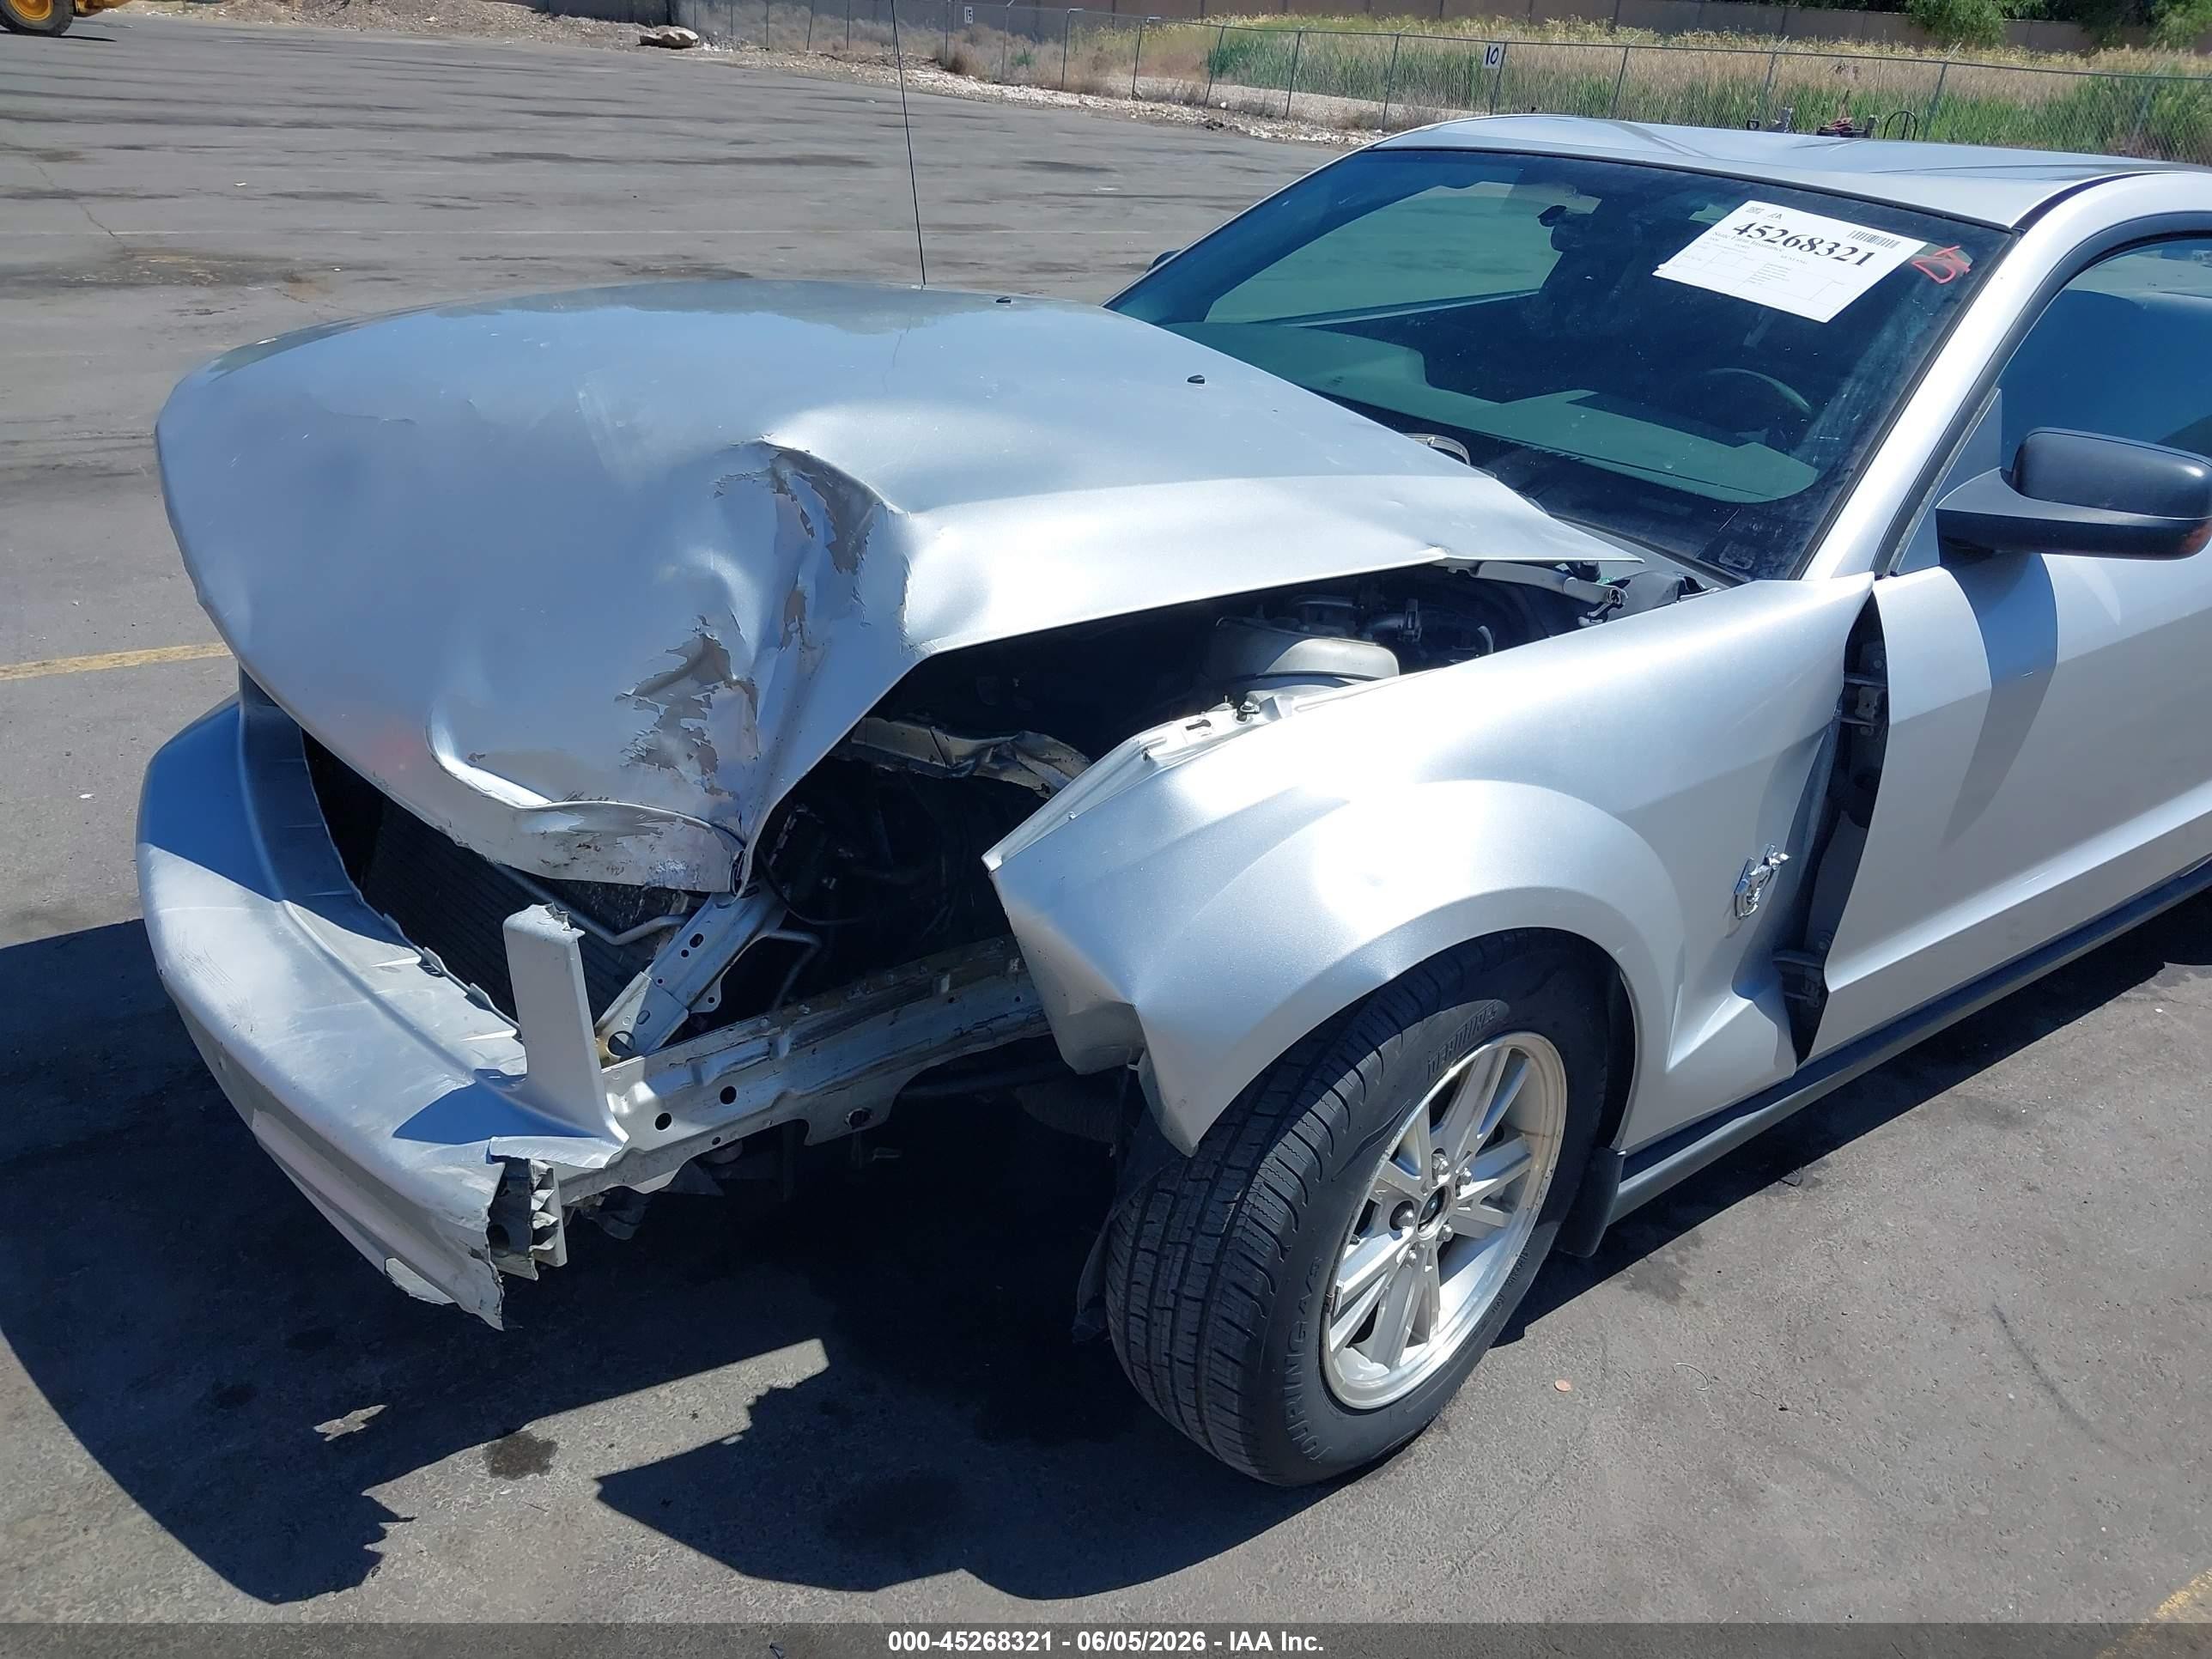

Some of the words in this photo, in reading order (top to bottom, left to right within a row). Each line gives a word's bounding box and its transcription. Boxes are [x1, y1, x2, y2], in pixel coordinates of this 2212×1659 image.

[1486, 46, 1499, 66] 10
[1731, 222, 1875, 267] 45268321
[1283, 1320, 1332, 1464] TOURING
